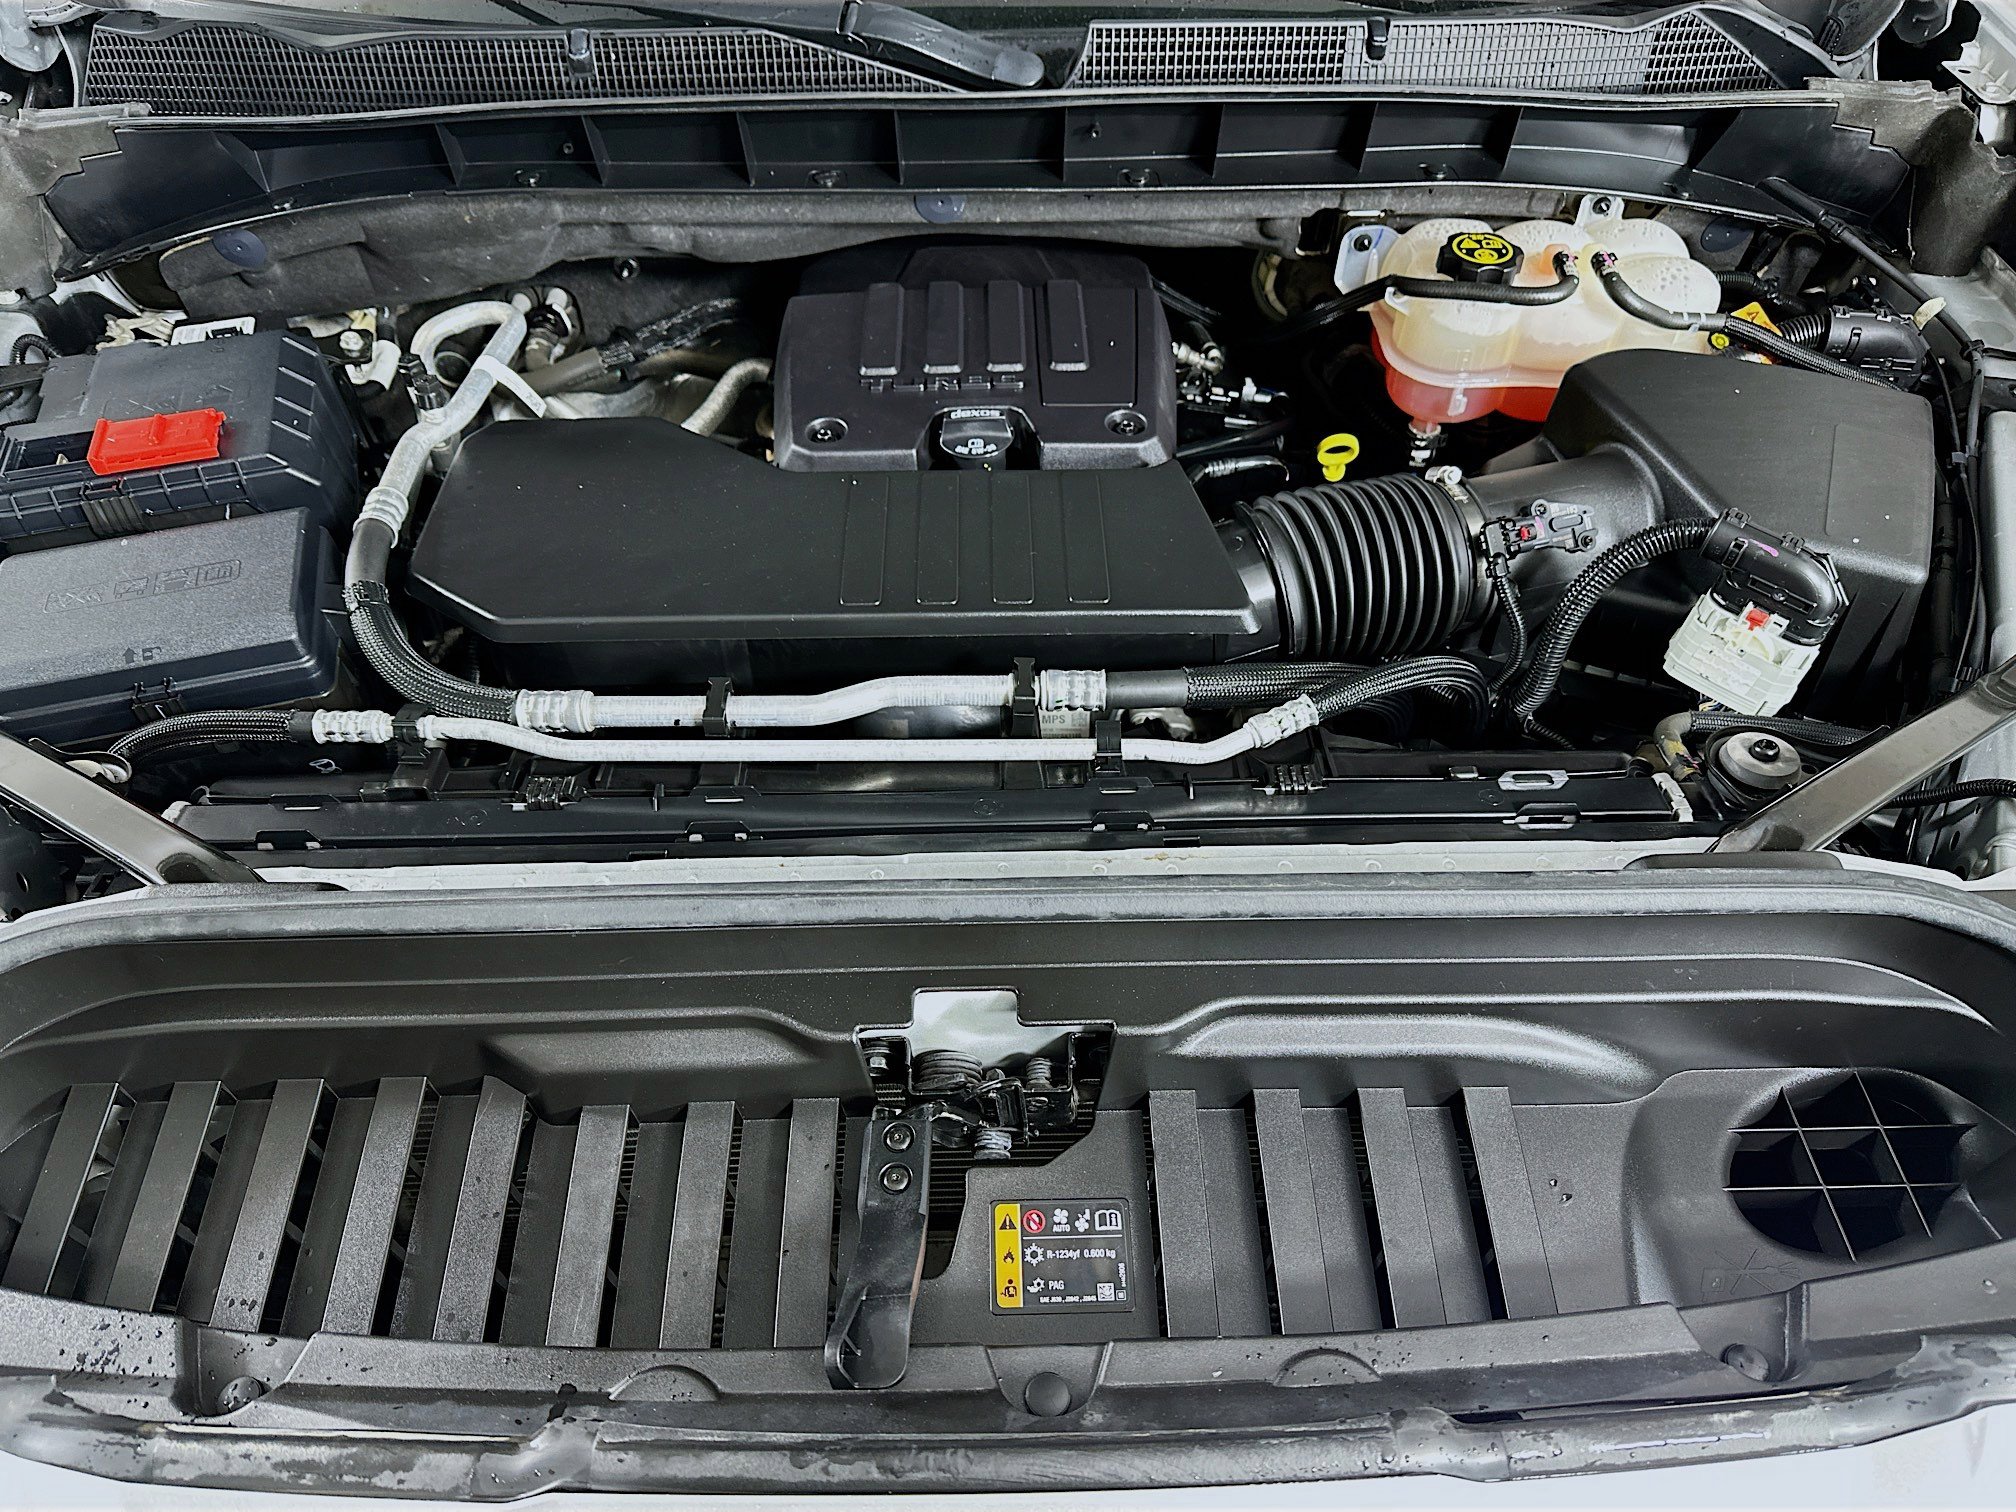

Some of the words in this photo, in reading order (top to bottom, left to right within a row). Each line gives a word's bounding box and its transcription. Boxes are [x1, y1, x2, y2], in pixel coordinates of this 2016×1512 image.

[950, 408, 1001, 419] dexos
[1041, 714, 1066, 724] MPS
[1052, 1224, 1071, 1233] AUTO
[1046, 1249, 1080, 1260] R-1234yf
[1105, 1248, 1116, 1259] kg
[1048, 1280, 1065, 1290] PAG
